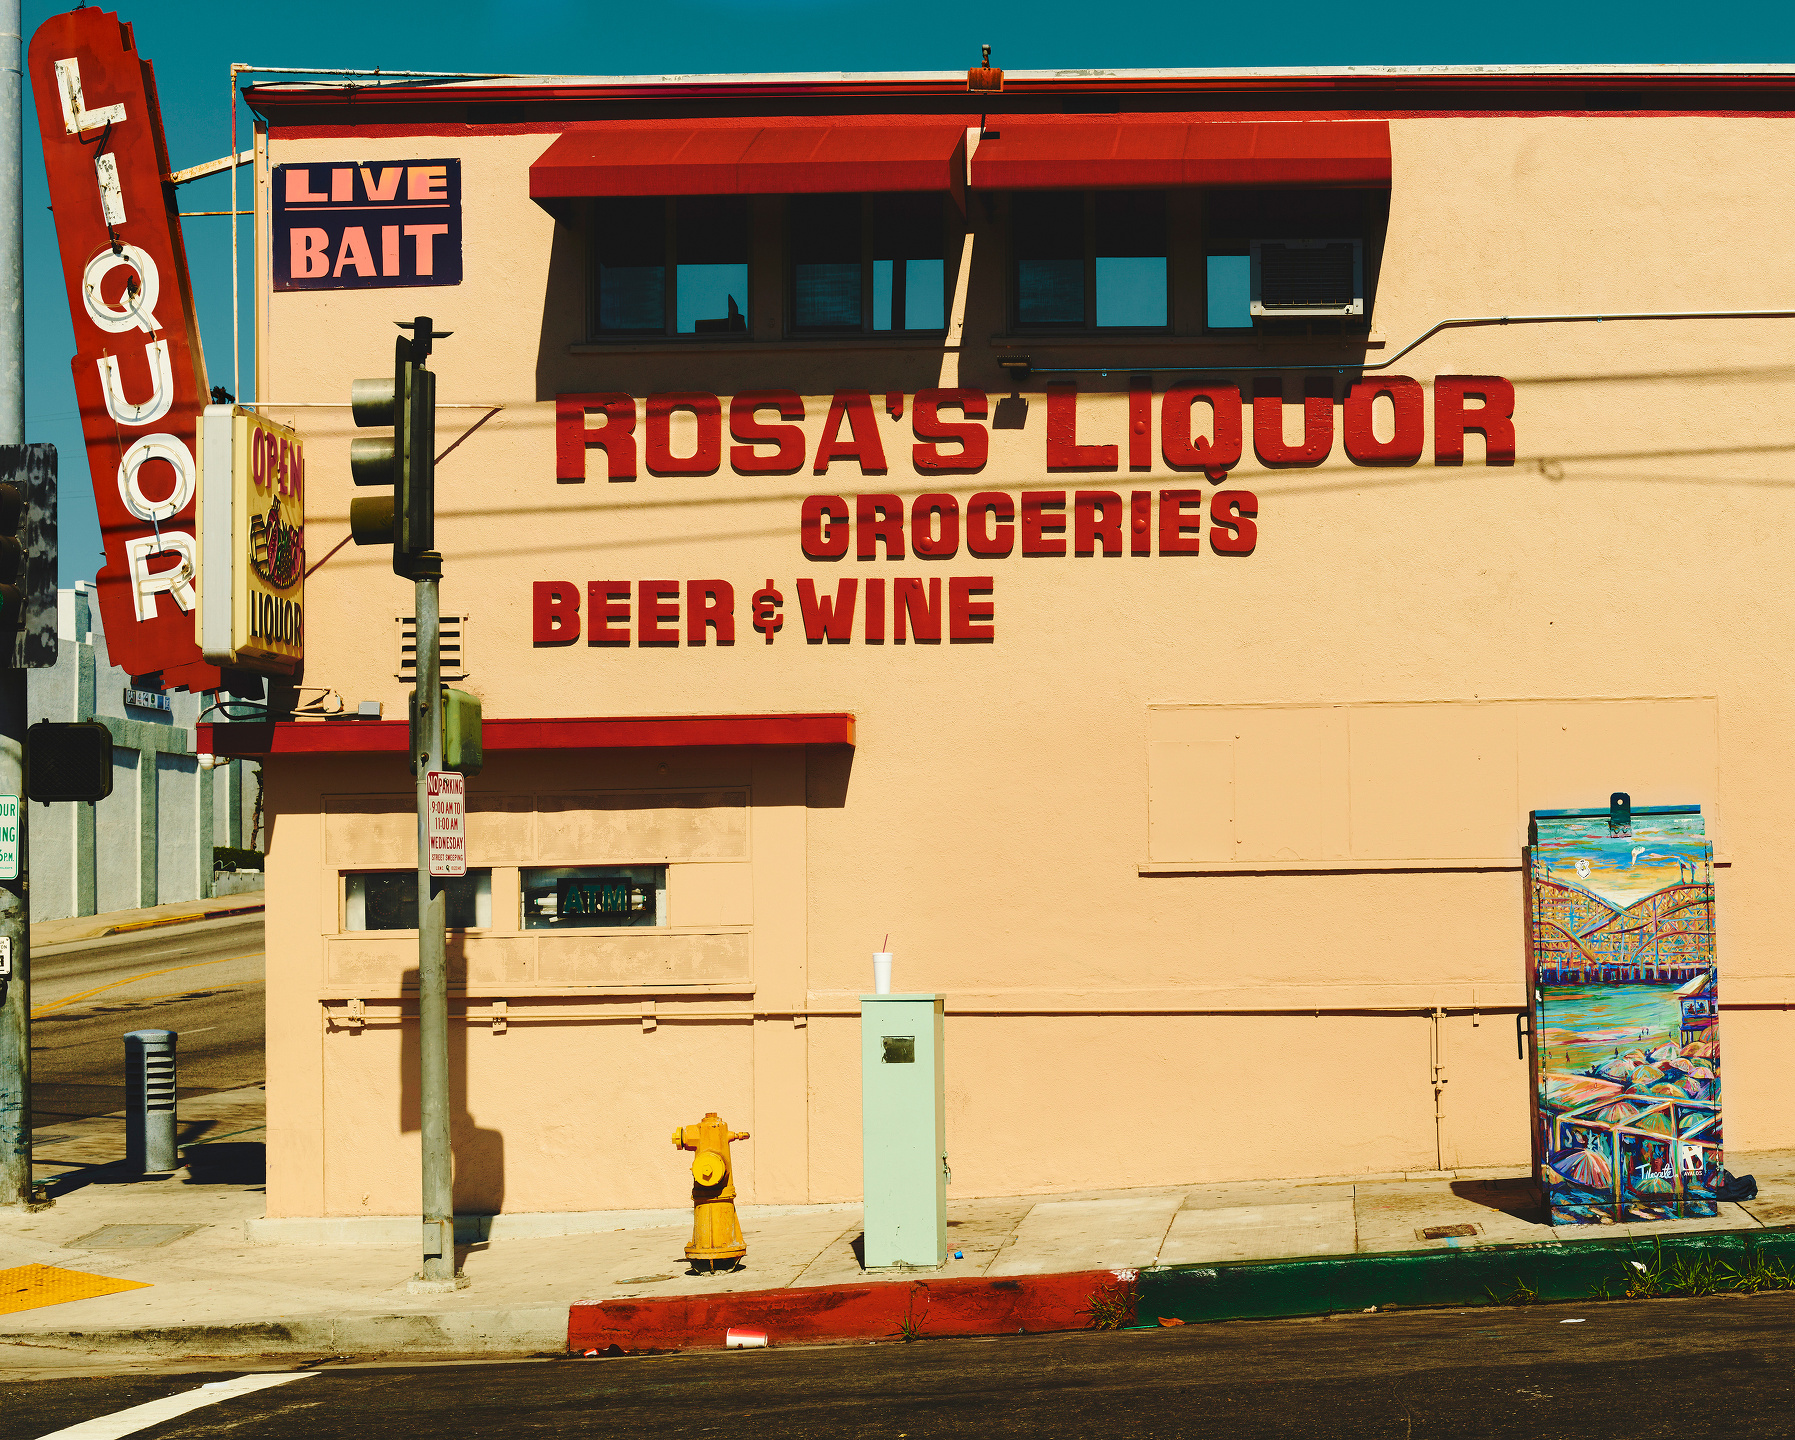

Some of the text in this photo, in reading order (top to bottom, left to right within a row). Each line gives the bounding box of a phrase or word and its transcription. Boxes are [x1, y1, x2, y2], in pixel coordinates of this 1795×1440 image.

[285, 166, 448, 203] LIVE
[290, 223, 449, 279] BAIT
[54, 56, 196, 622] LIQUOR
[556, 375, 1515, 483] ROSA'S LIQUOR
[252, 426, 302, 501] OPEN
[801, 490, 1258, 560] GROCERIES
[250, 589, 302, 648] LIQUOR
[533, 576, 995, 647] BEER & WINE
[428, 775, 463, 795] NO PARKING
[431, 800, 461, 815] 9:00 AM TO
[430, 836, 464, 850] WEDNESDAY
[434, 817, 459, 831] 11:00 AM
[563, 884, 626, 914] ATM
